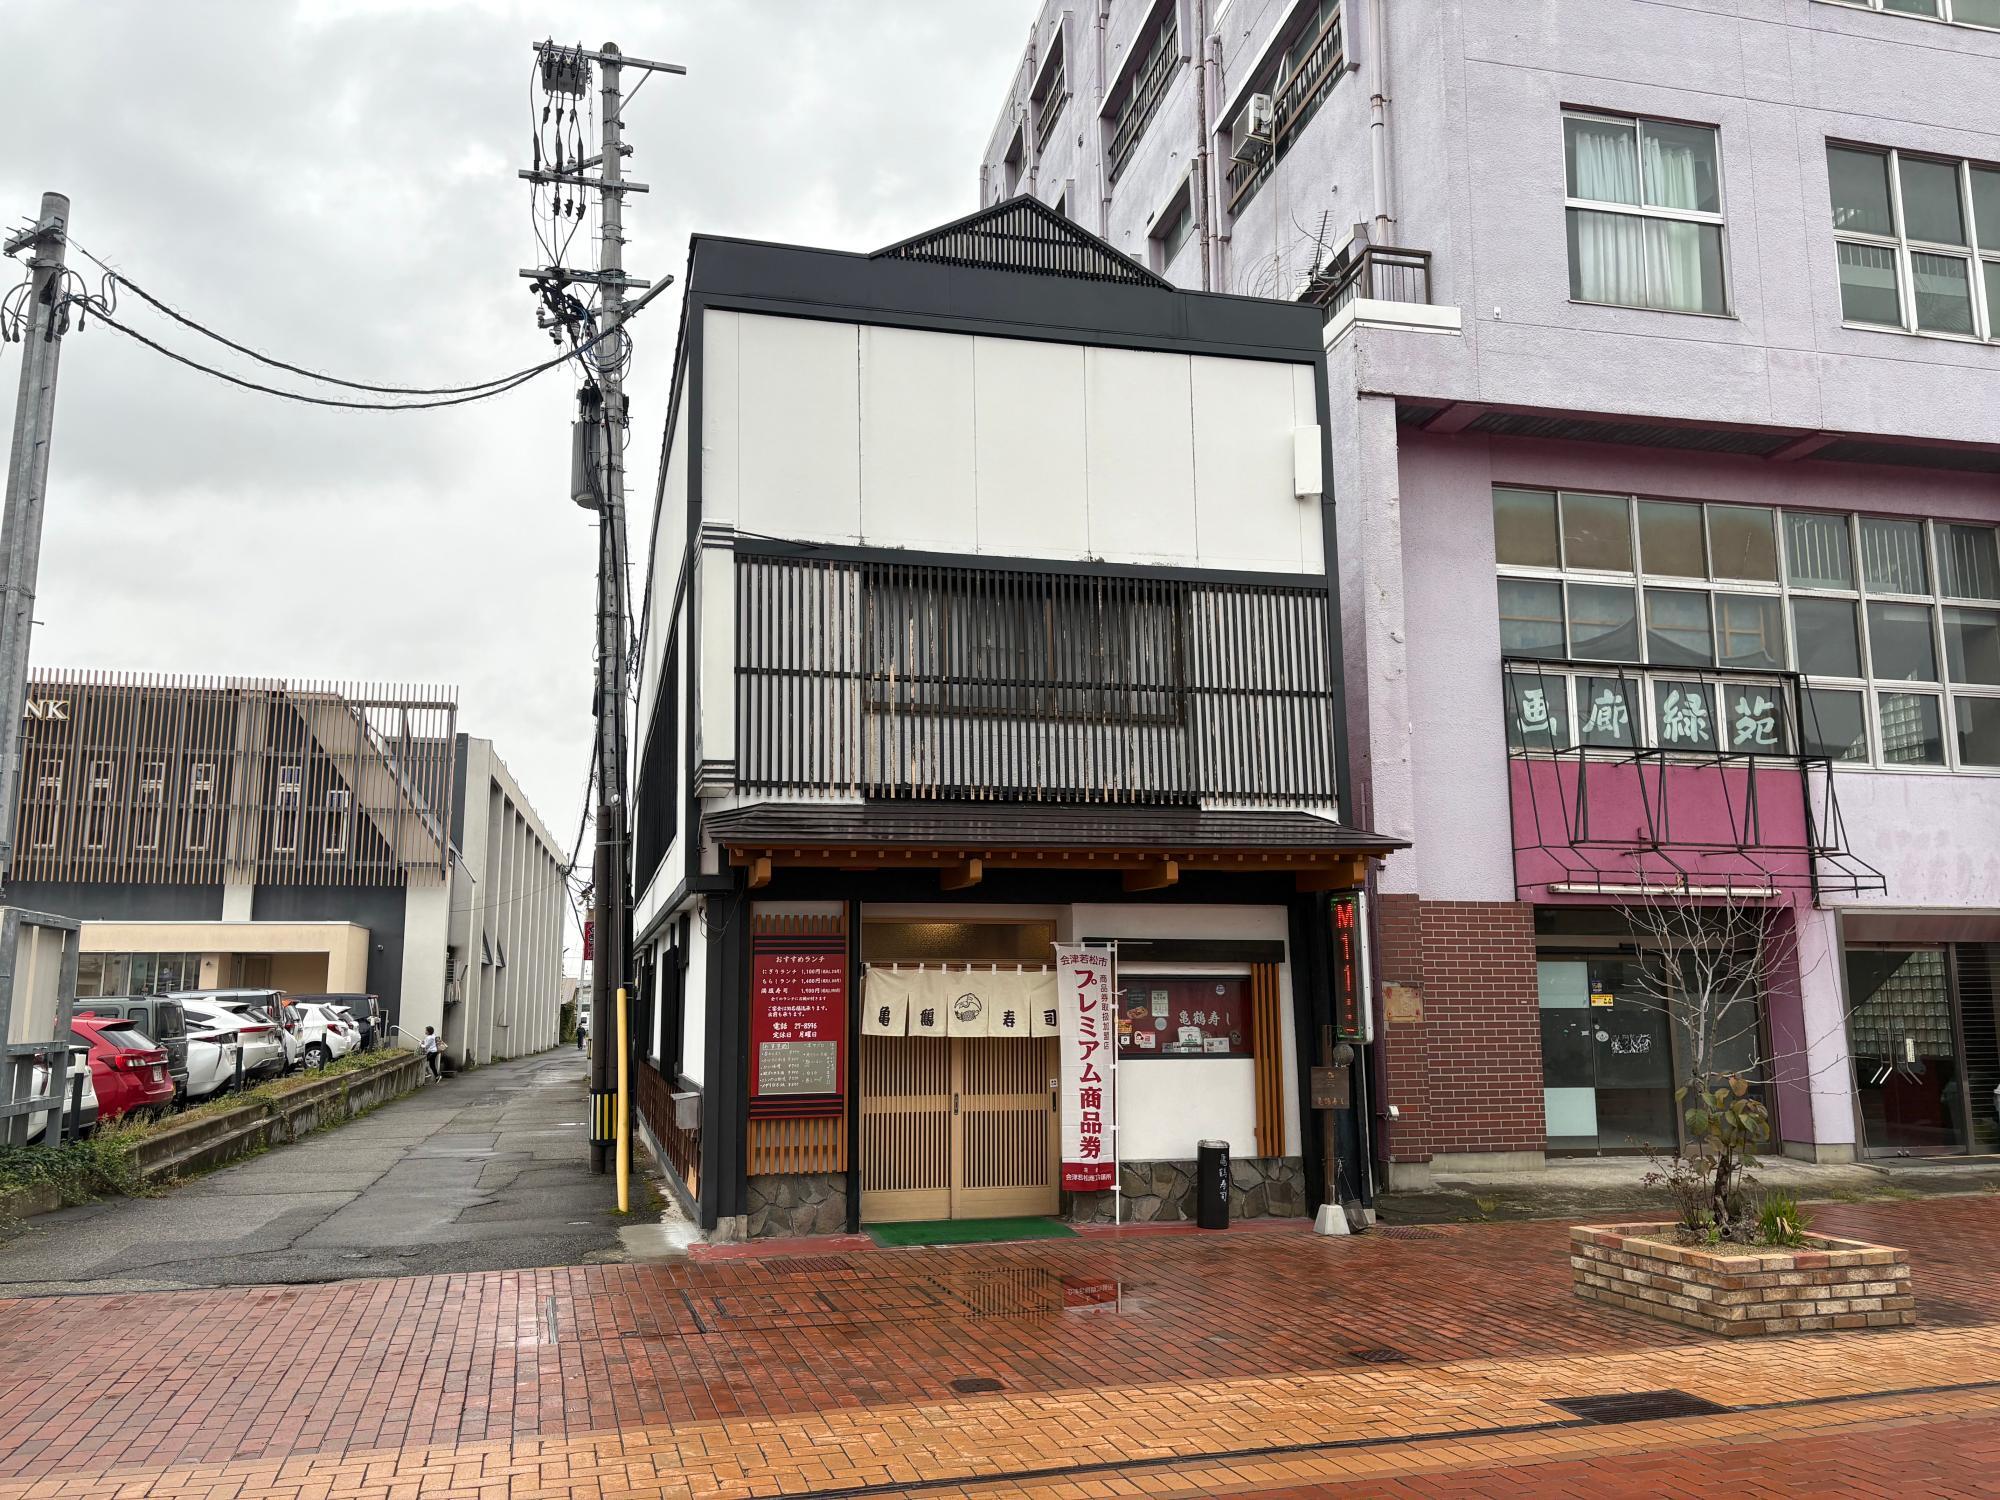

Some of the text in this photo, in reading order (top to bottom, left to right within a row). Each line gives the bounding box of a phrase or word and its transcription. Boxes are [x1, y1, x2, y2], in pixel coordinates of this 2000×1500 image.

[776, 955, 825, 963] おすすめランチ
[1060, 954, 1108, 967] 会津若松市
[1099, 974, 1110, 1050] 商品券取扱加盟店
[772, 1022, 788, 1030] 電話
[772, 1030, 817, 1039] 定休日 月曜日
[1074, 969, 1103, 1160] プレミアム商品券
